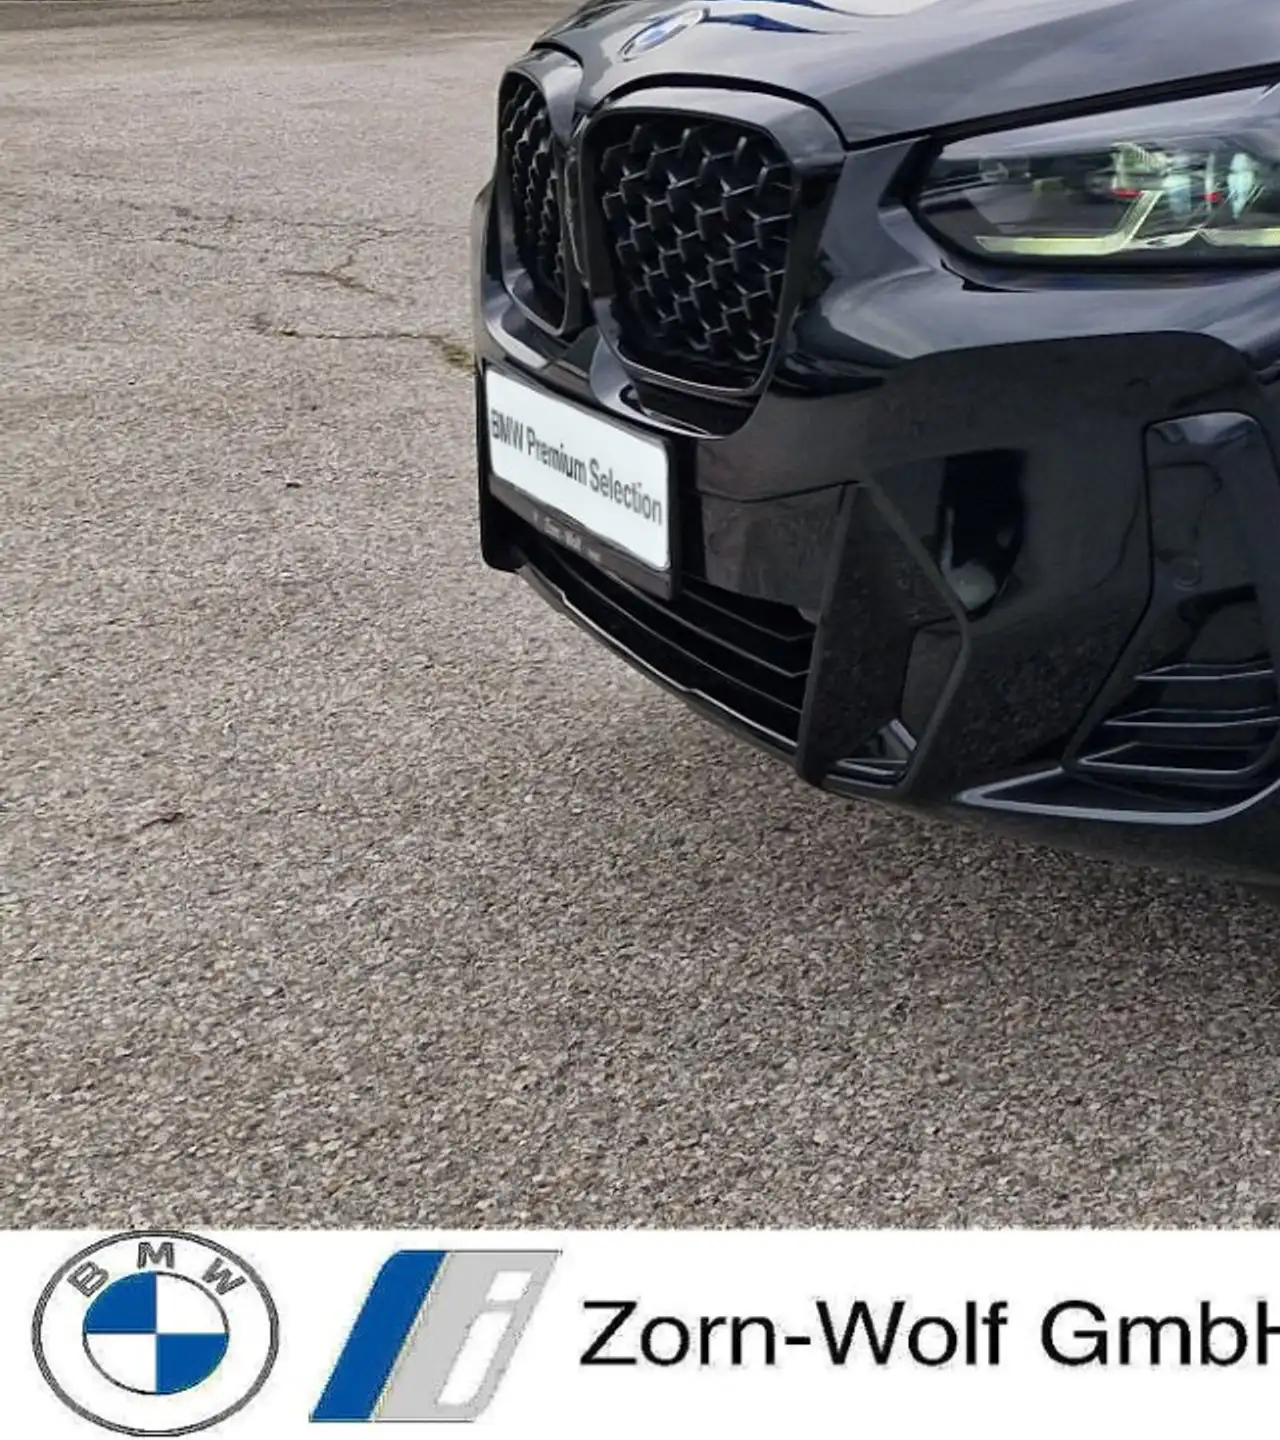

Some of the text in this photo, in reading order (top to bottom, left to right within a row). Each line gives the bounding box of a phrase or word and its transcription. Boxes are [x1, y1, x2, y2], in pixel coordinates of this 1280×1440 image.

[490, 409, 662, 526] BMW Premium Selection
